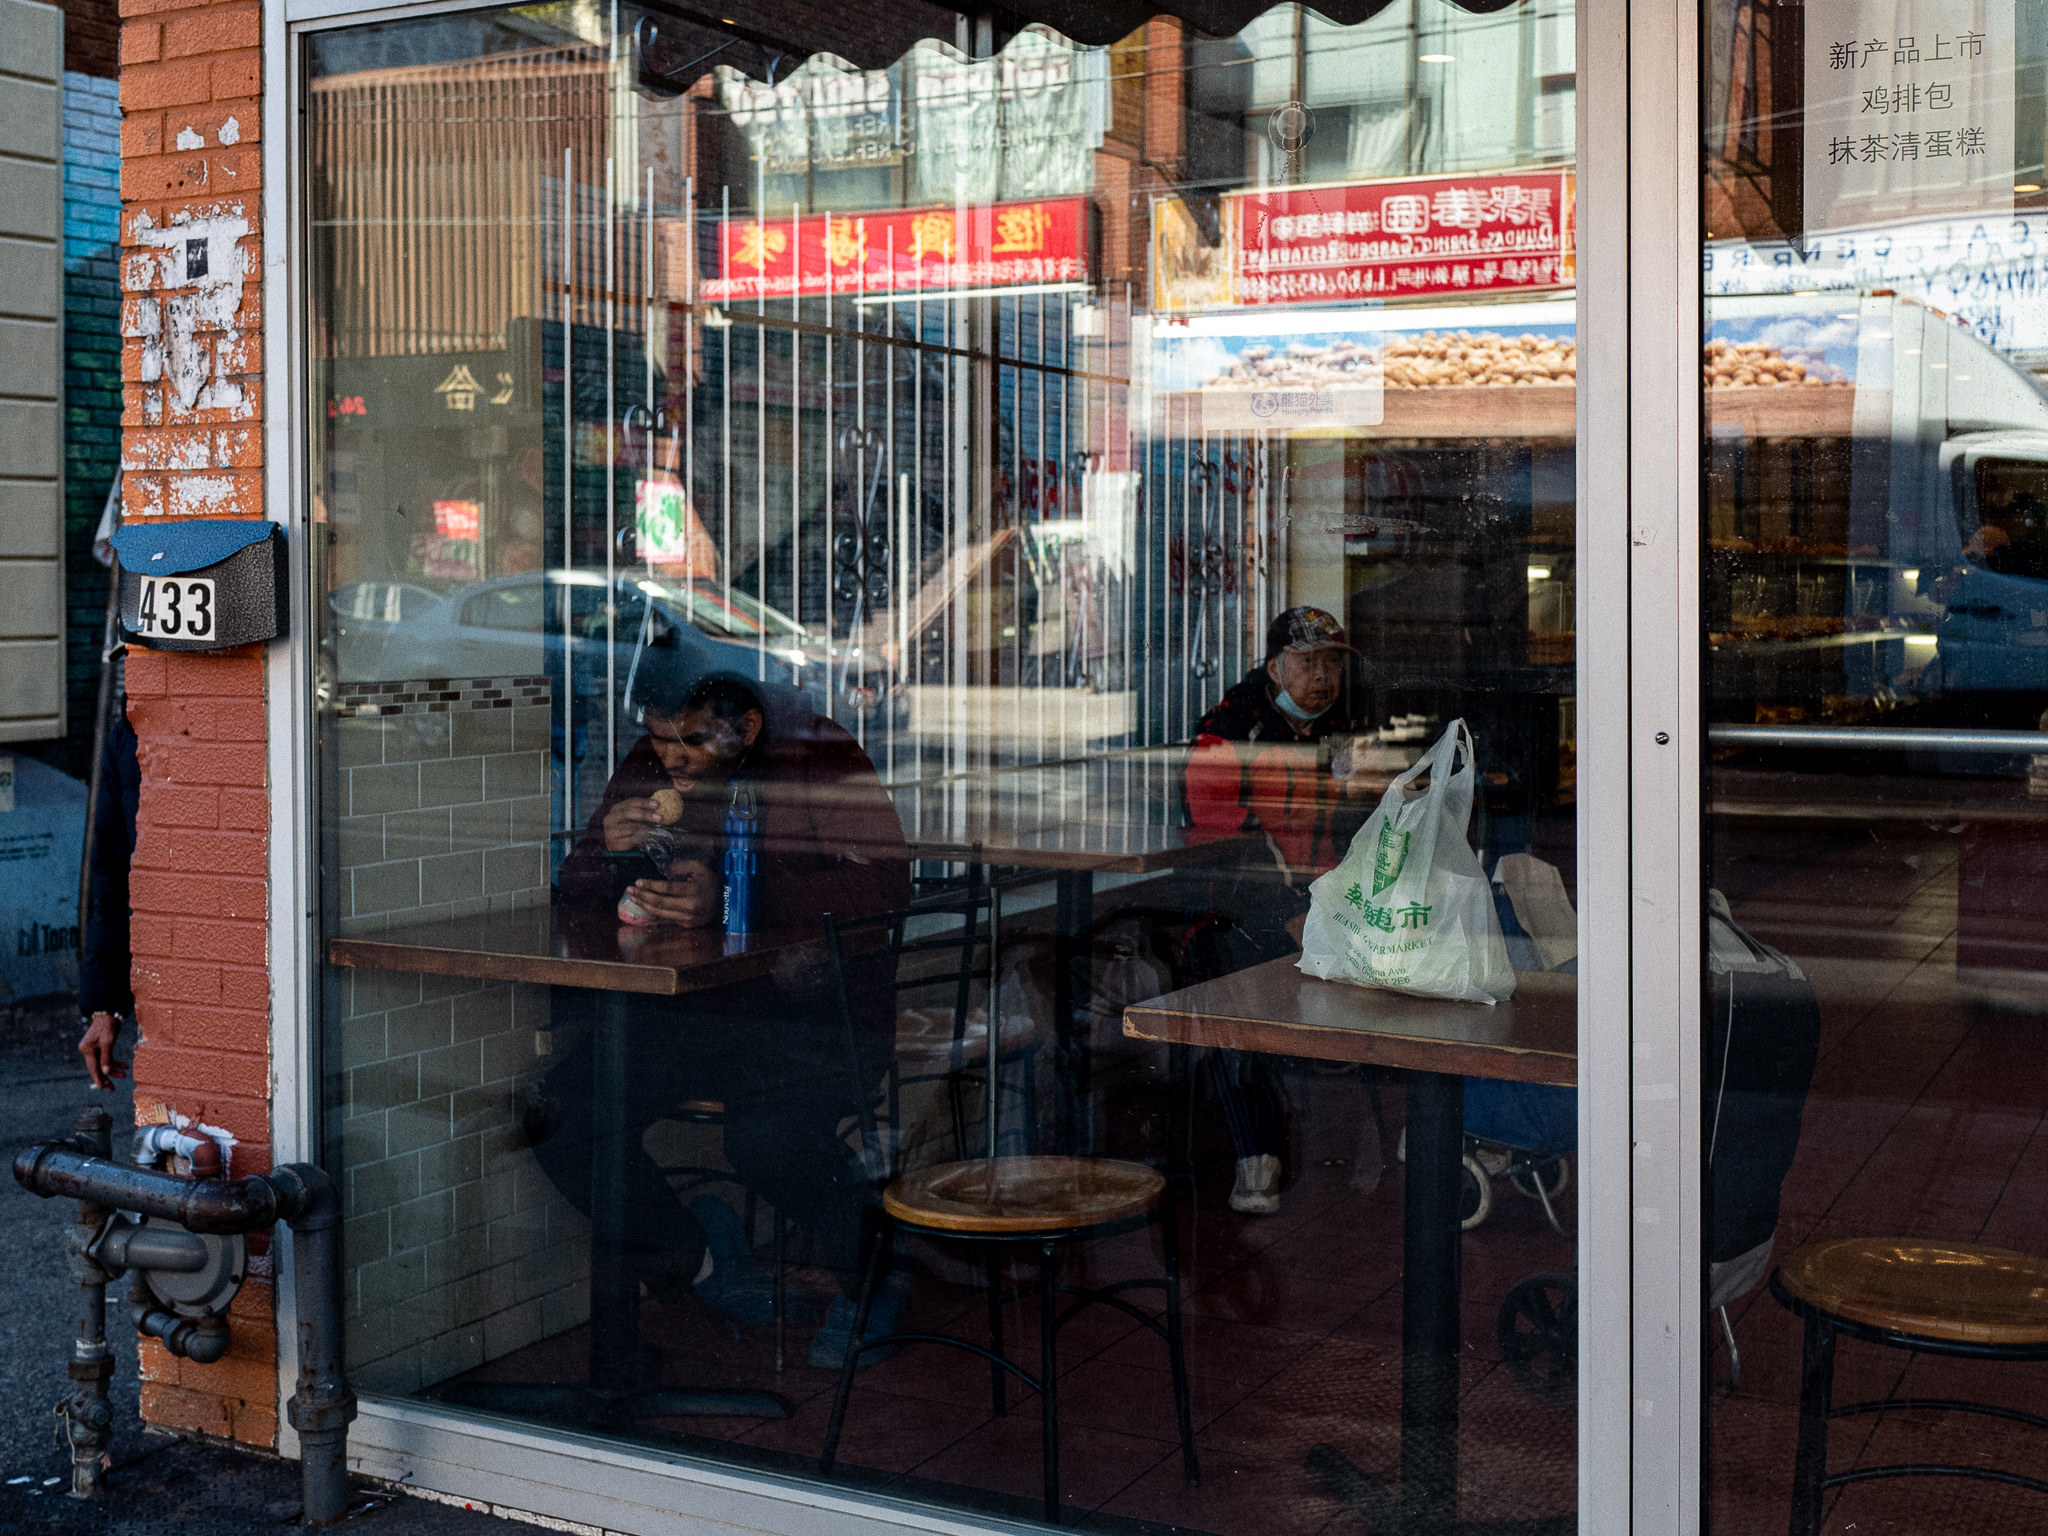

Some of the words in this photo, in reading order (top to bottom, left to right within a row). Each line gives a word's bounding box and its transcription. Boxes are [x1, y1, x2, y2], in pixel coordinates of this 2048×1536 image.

[1829, 30, 1986, 69] 新产品上市
[1861, 82, 1954, 115] 鸡排包
[1828, 126, 1987, 165] 抹茶清蛋糕
[1281, 392, 1334, 408] 熊猫外卖
[1281, 407, 1334, 418] HungryPanda
[139, 580, 212, 636] 433
[1333, 911, 1350, 927] HUA
[1388, 967, 1409, 977] Ave.
[1391, 975, 1411, 986] 2E6
